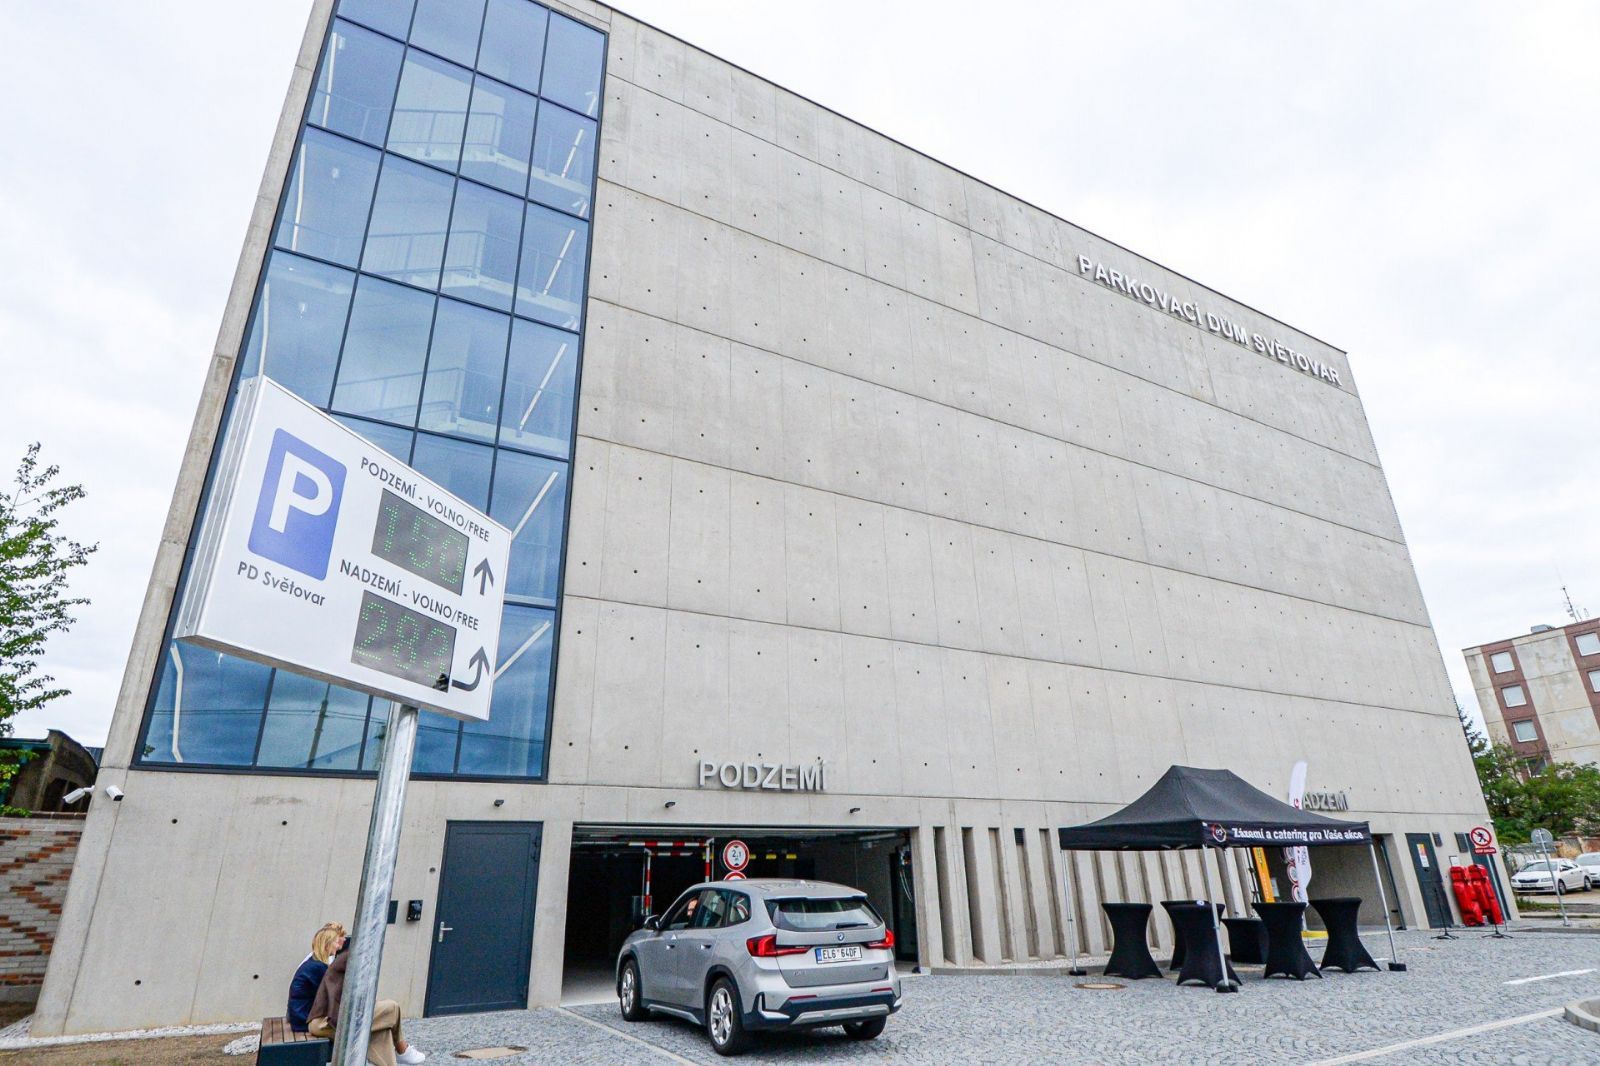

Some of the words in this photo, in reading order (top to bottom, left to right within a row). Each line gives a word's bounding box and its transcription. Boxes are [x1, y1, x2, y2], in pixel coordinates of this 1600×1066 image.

[1077, 253, 1203, 326] PARKOVACÍ
[1205, 311, 1249, 345] DŮM
[1252, 332, 1342, 386] SVĚTOVAR
[268, 450, 333, 533] P
[361, 457, 417, 499] PODZEMÍ
[427, 496, 490, 542] VOLNO/FREE
[384, 504, 465, 584] 150
[237, 561, 259, 580] PD
[262, 571, 326, 606] Světovar
[339, 559, 402, 598] NADZEMÍ
[412, 590, 480, 631] VOLNO/FREE
[698, 760, 828, 791] PODZEMÍ
[1302, 790, 1349, 811] ADZEMÍ
[1231, 827, 1265, 839] Zázemí
[1265, 830, 1272, 839] a
[1273, 828, 1308, 841] catering
[1309, 831, 1323, 841] pro
[1322, 829, 1343, 840] Vaše
[1343, 829, 1364, 840] akce
